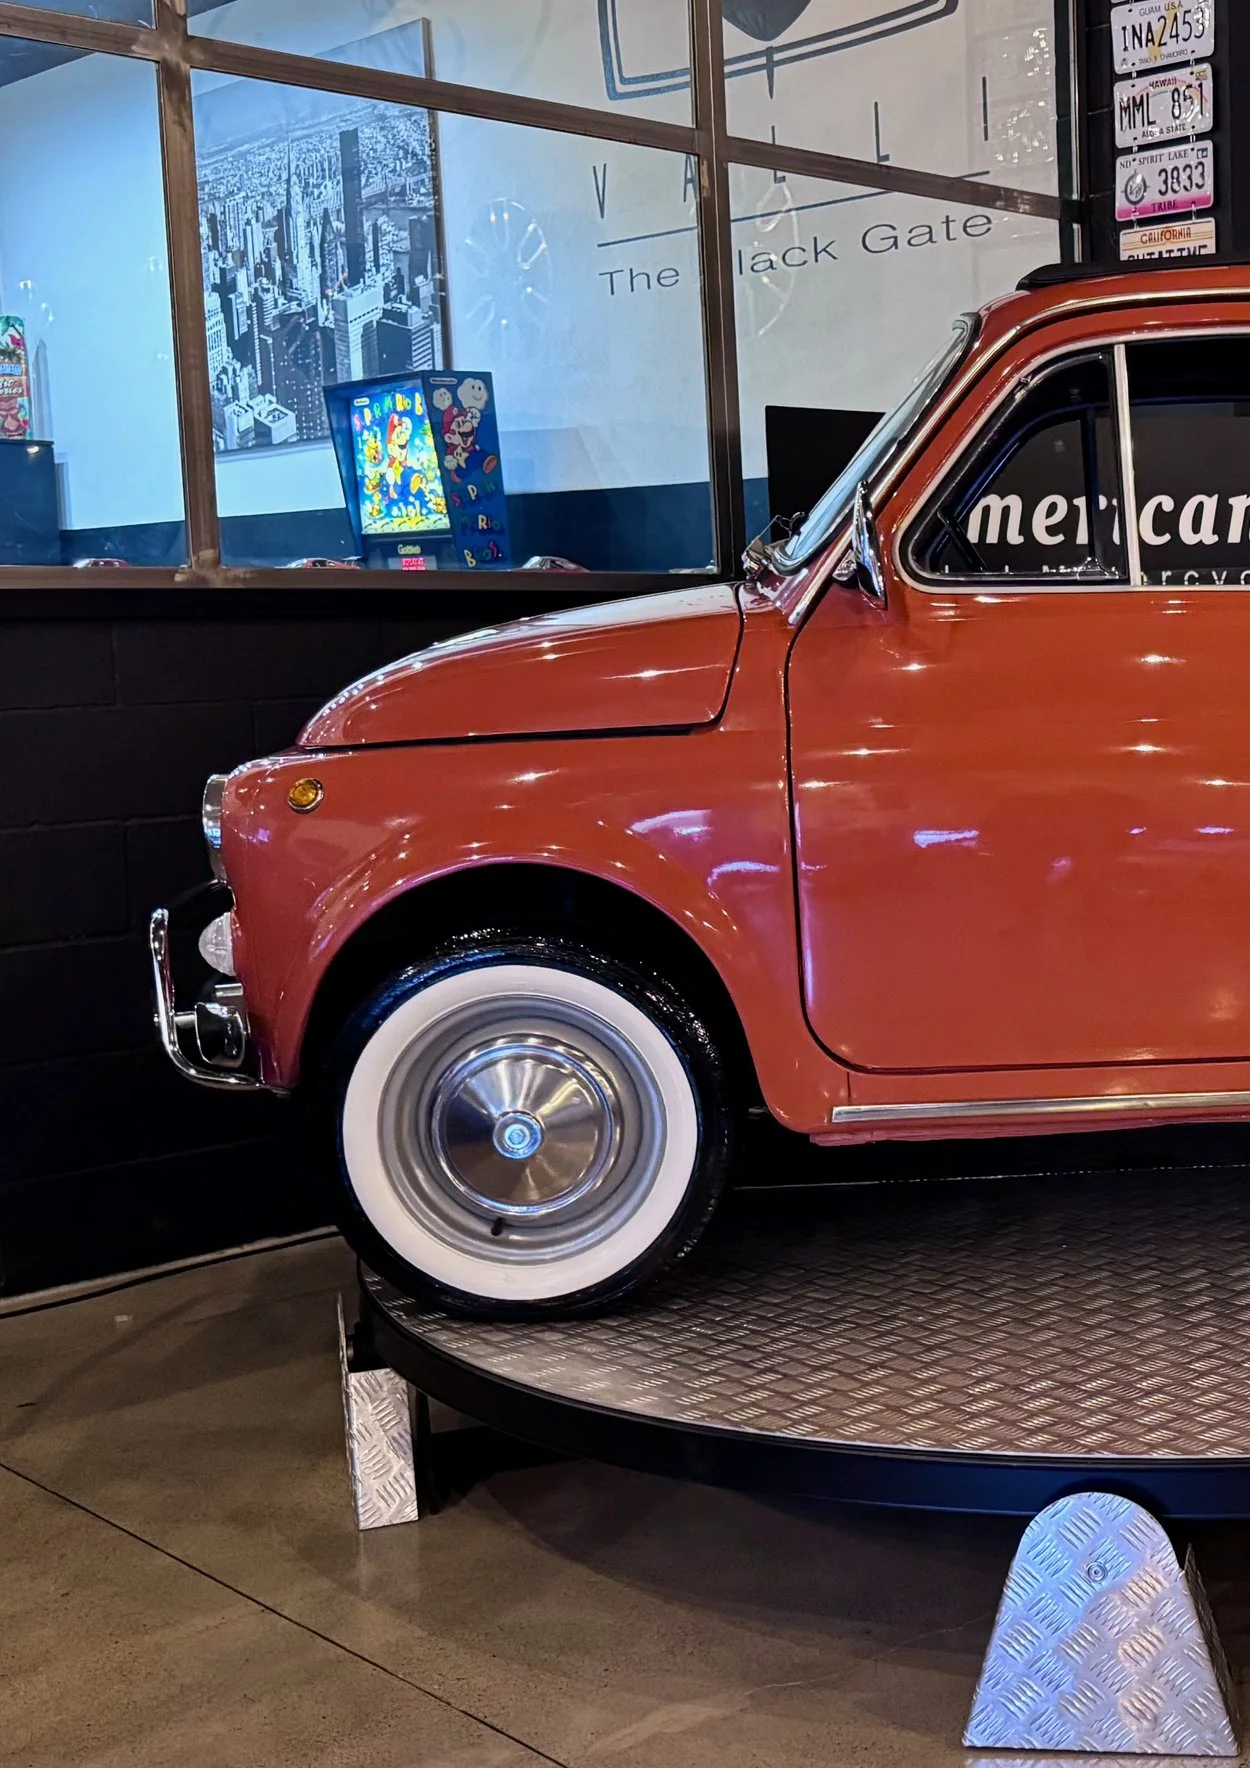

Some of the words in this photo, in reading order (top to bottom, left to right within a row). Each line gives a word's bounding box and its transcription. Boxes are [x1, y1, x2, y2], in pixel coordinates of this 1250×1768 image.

[1140, 5, 1160, 17] GUAM
[1121, 7, 1205, 52] INA2453
[1149, 76, 1177, 90] HAWAII
[1119, 92, 1157, 133] MML
[1171, 81, 1204, 120] 851
[1141, 126, 1164, 138] ALOA
[1166, 123, 1187, 135] STATE
[1120, 160, 1132, 169] ND
[1138, 153, 1165, 166] SPIRIT
[1168, 148, 1189, 161] LAKE
[1158, 161, 1206, 197] 3833
[1151, 199, 1178, 213] TRIBE
[1140, 226, 1192, 245] CALIFORNIA
[598, 265, 681, 296] The
[737, 236, 839, 277] lack
[860, 213, 993, 255] Gate
